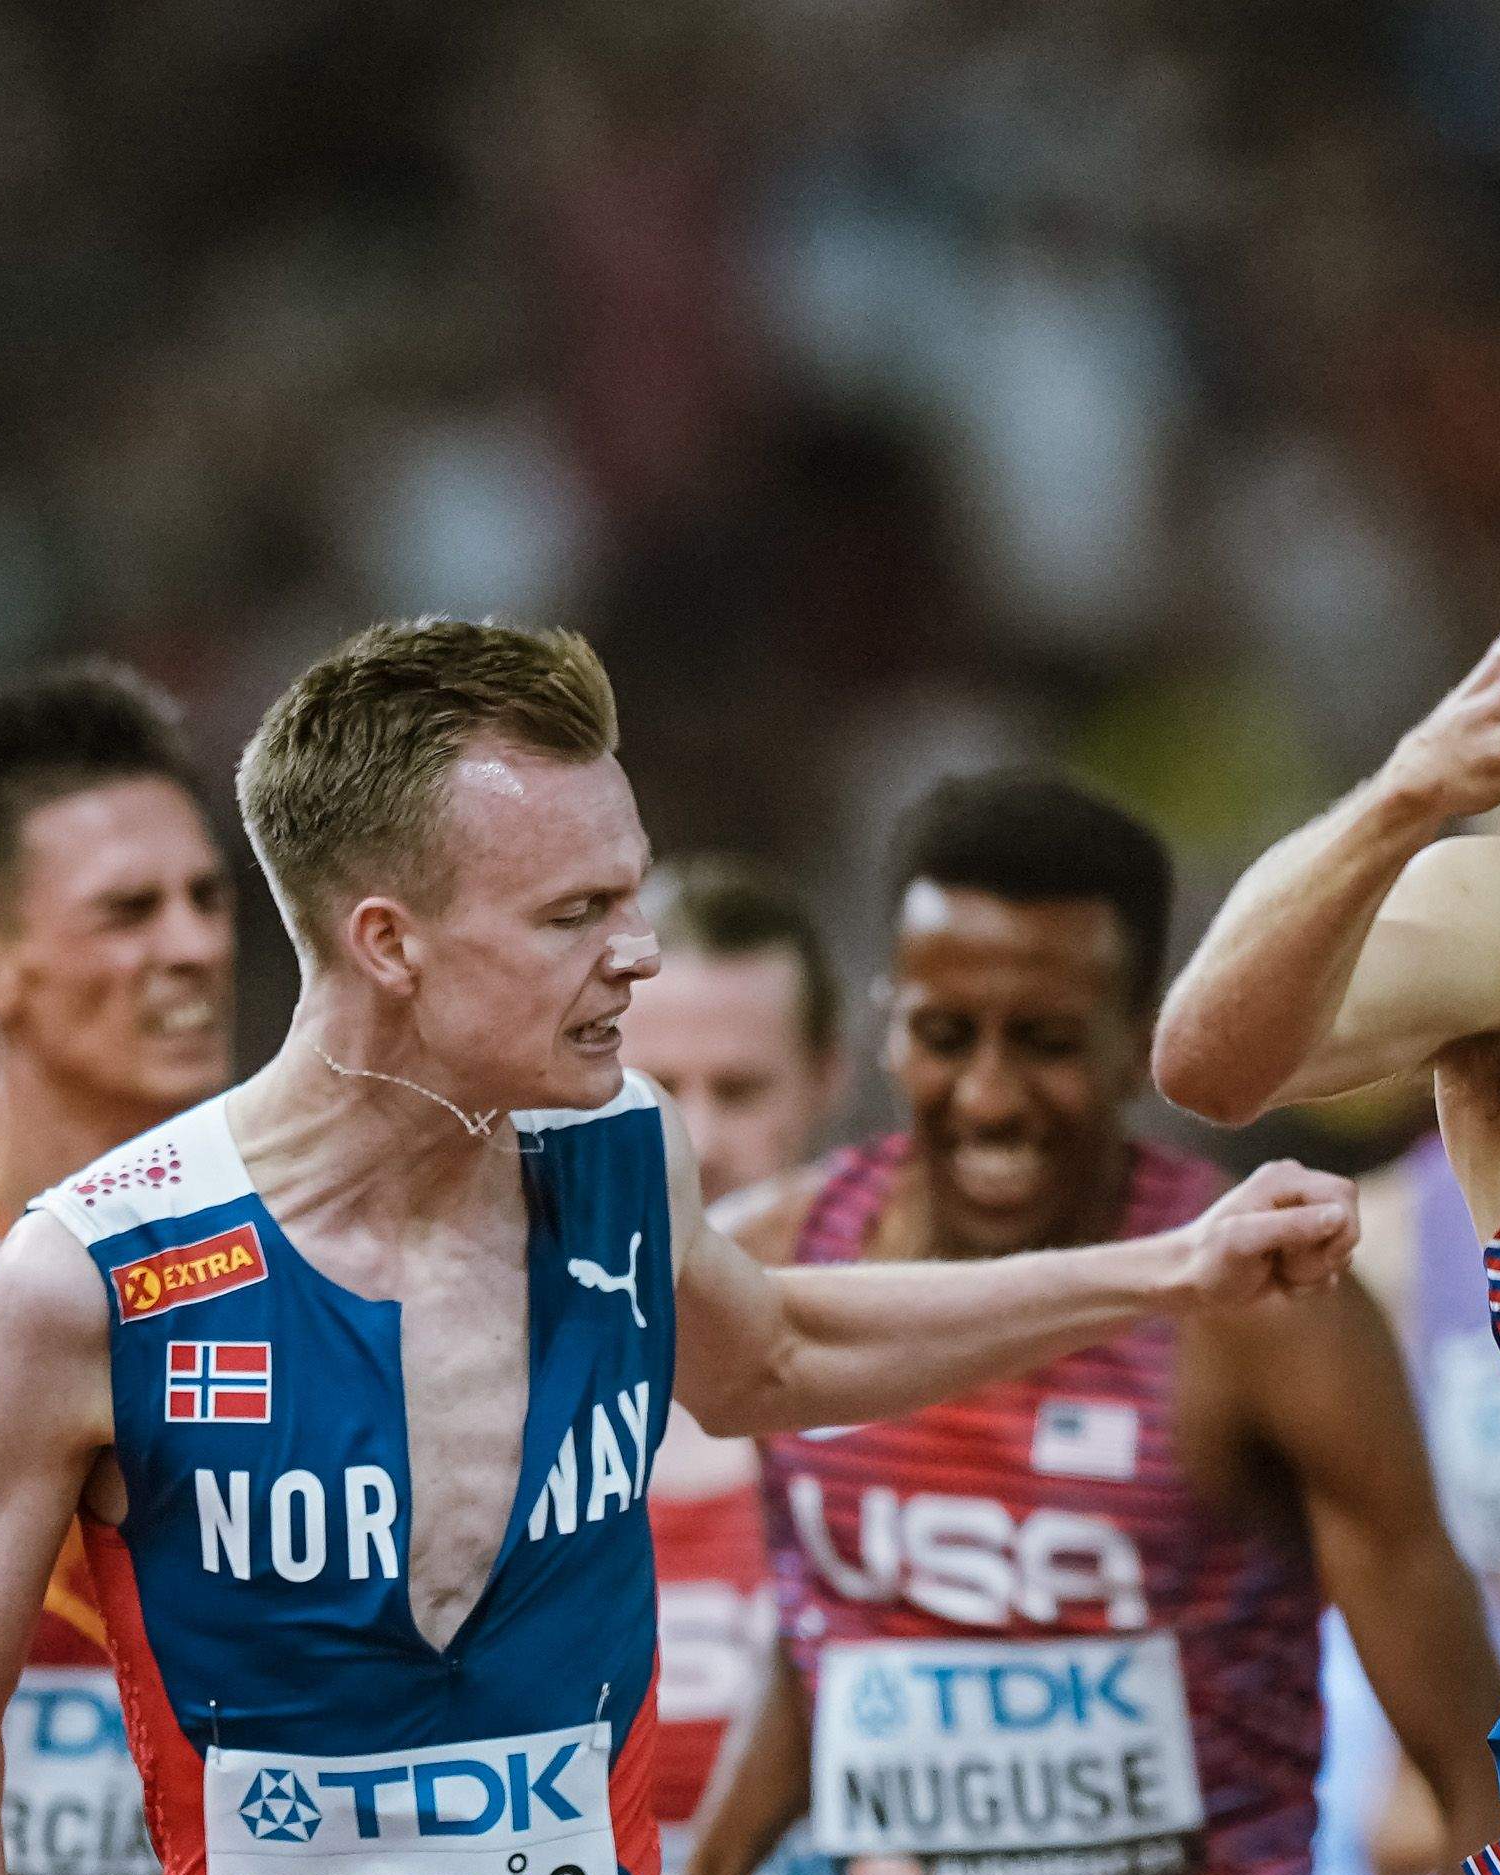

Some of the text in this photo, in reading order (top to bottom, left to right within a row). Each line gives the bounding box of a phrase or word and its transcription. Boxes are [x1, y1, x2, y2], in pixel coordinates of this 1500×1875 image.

[162, 1245, 254, 1291] EXTRA
[788, 1474, 1150, 1630] USA
[912, 1654, 1142, 1731] TDK
[319, 1742, 583, 1841] TDK
[844, 1747, 1166, 1834] NUGUSE
